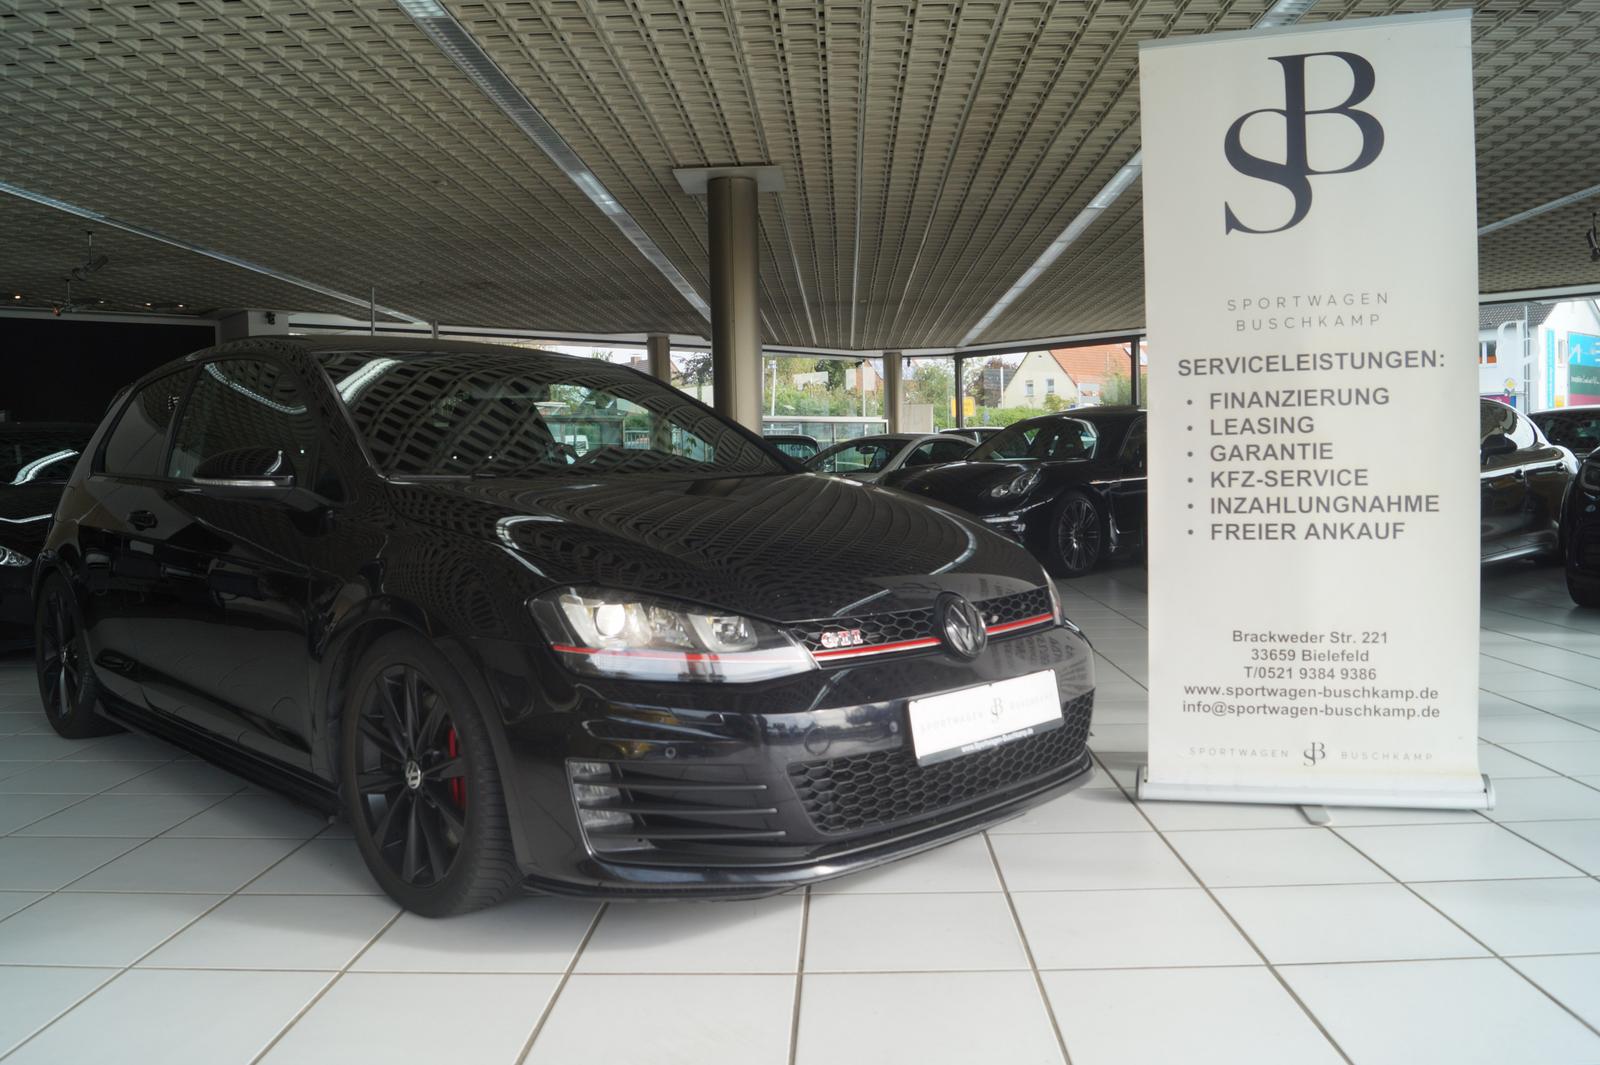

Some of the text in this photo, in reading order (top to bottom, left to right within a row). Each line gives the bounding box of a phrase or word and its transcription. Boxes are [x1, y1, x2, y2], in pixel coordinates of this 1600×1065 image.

[1227, 292, 1388, 312] SPORTWAGEN
[1236, 313, 1381, 332] BUSCHKAMP
[1178, 350, 1445, 376] SERVICELEISTUNGEN:
[1210, 388, 1390, 409] FINANZIERUNG
[1210, 416, 1314, 436] LEASING
[1210, 443, 1333, 462] GARANTIE
[1210, 469, 1368, 488] KFZ-SERVICE
[1210, 495, 1440, 514] INZAHLUNGNAHME
[1210, 522, 1405, 541] FREIER ANKAUF
[821, 629, 863, 648] GTI
[1232, 630, 1388, 644] Brackweder Str. 221
[1251, 649, 1369, 662] 33659 Bielefeld
[1244, 666, 1377, 681] T/0521 9384 9386
[1184, 685, 1439, 700] www.sportwagen-buschkamp.de
[1182, 700, 1440, 719] info@sportwagen-buschkamp.de
[1189, 746, 1290, 759] SPORTWAGEN
[1340, 751, 1434, 761] BUSCHKAMP
